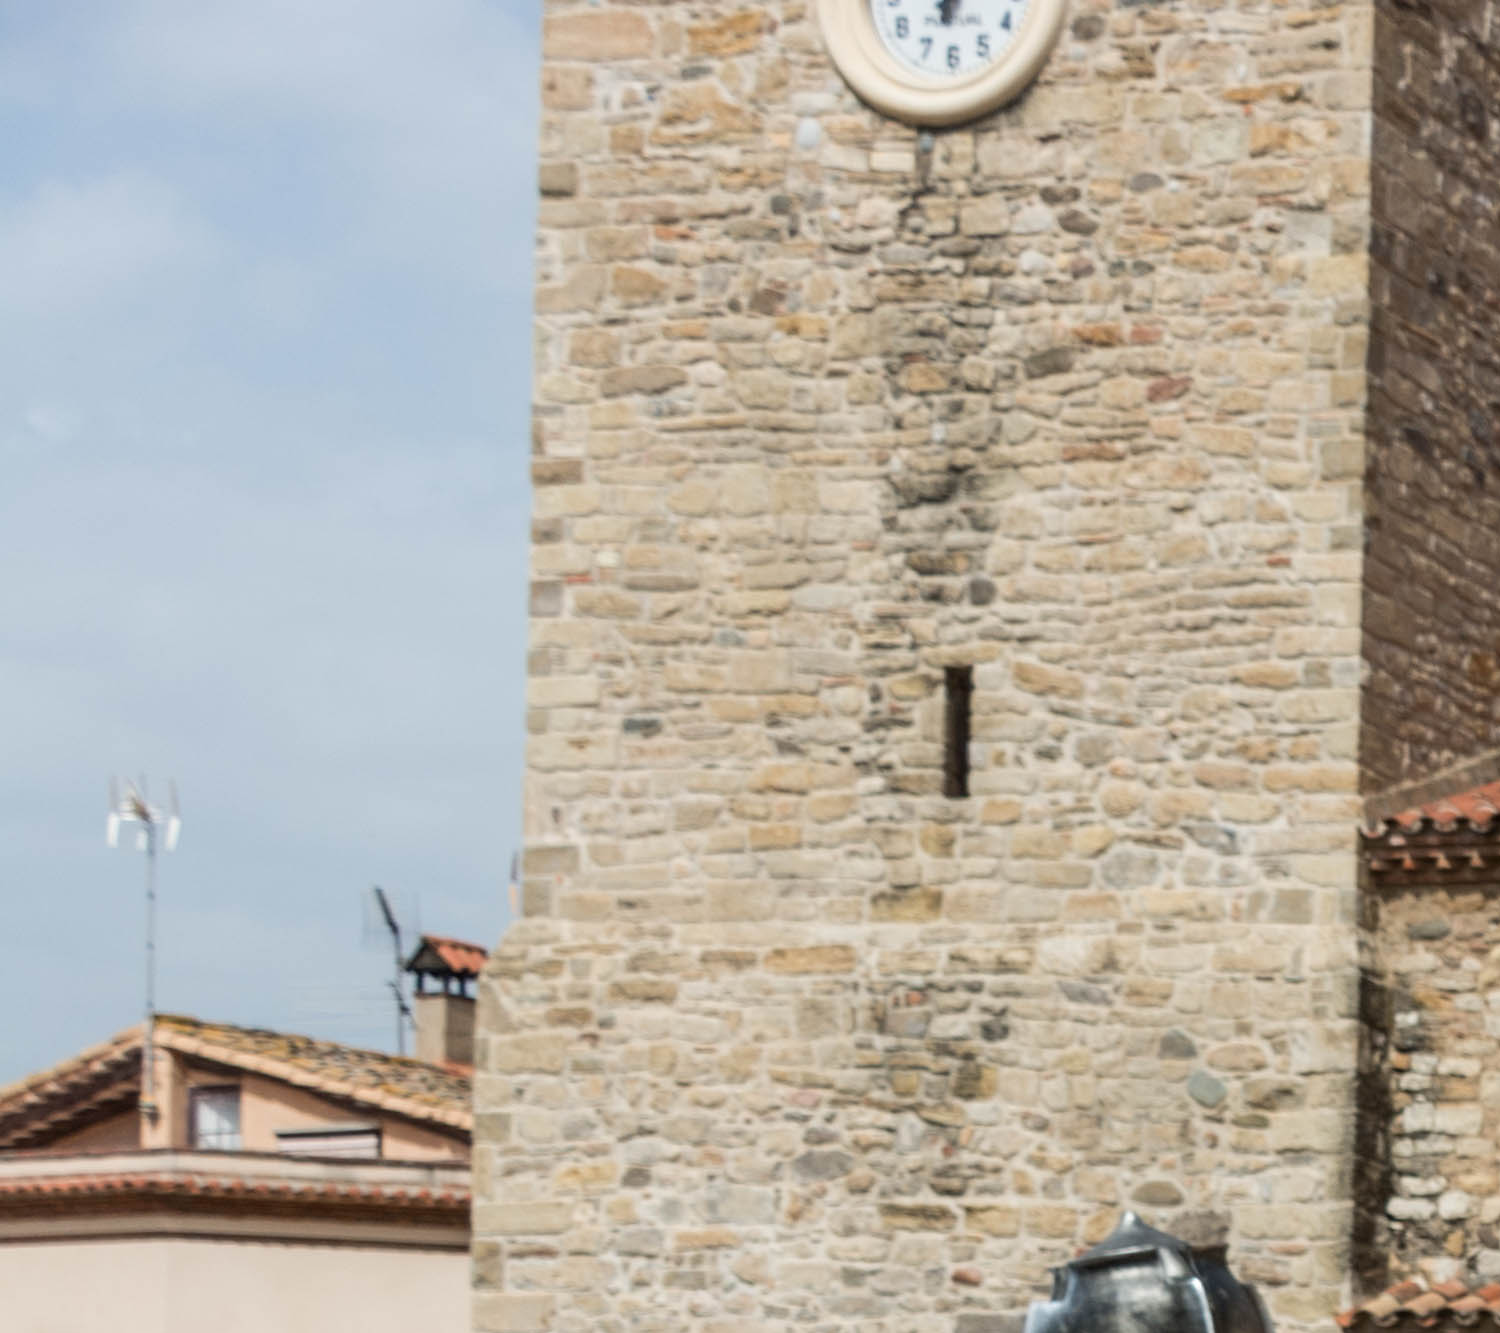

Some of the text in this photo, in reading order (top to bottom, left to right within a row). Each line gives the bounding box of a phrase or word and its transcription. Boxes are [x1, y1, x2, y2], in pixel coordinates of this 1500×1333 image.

[1000, 10, 1012, 30] 4
[920, 37, 933, 59] 7
[947, 45, 960, 68] 6
[976, 34, 989, 57] 5
